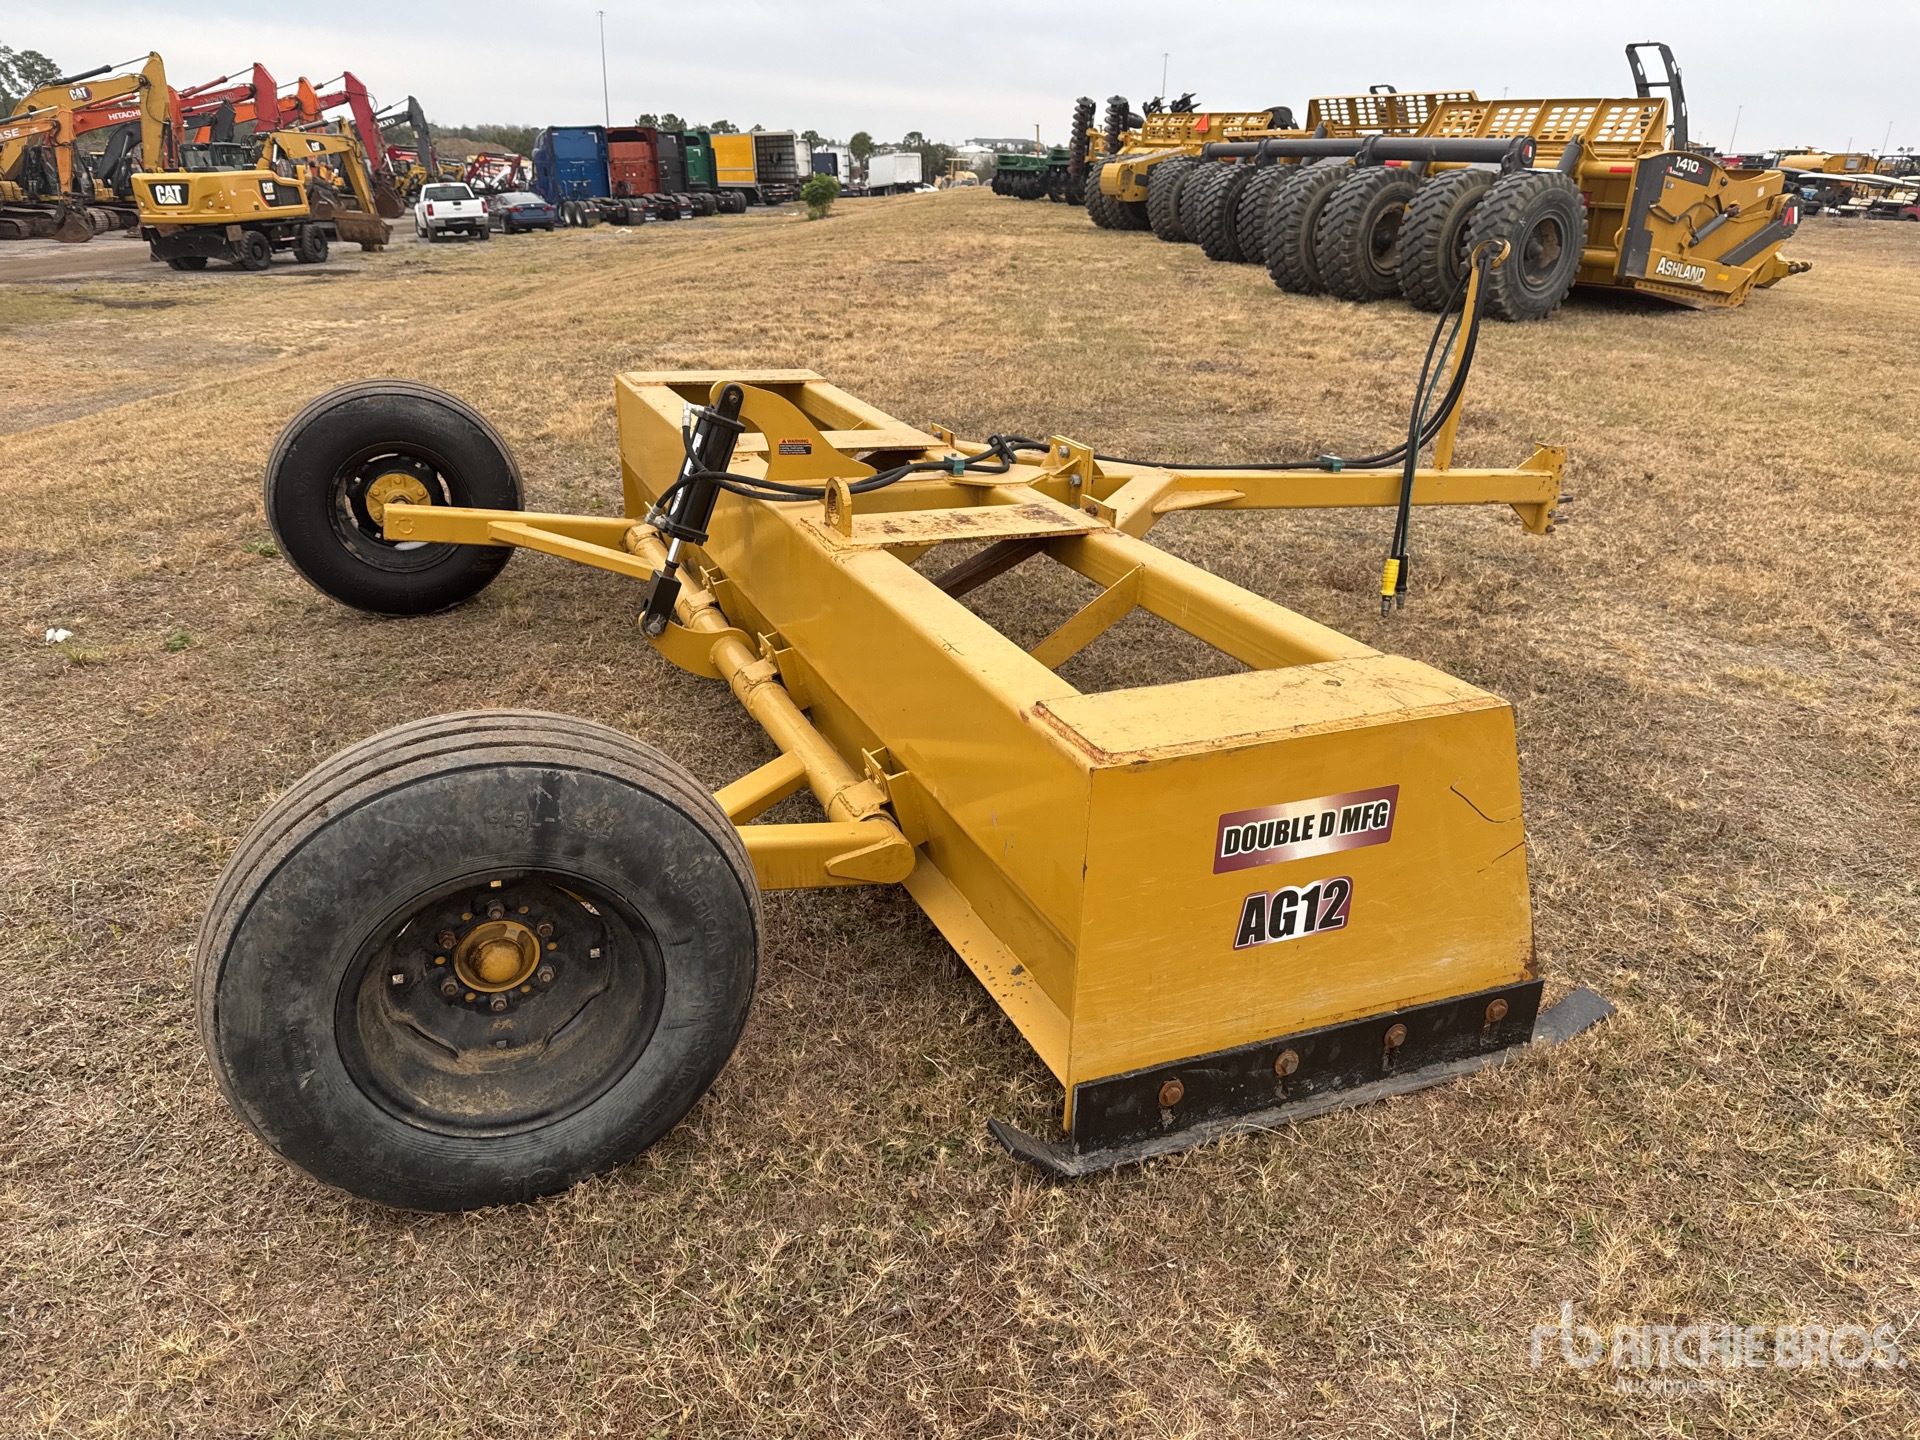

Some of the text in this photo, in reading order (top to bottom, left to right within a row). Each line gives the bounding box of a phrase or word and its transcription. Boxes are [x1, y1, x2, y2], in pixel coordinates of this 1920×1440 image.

[69, 86, 88, 100] CAT
[108, 110, 142, 121] HITACHI
[155, 185, 182, 204] CAT
[262, 182, 274, 193] CAT
[1655, 257, 1706, 283] ASHLAND
[1223, 801, 1389, 856] DOUBLE D MFG
[1236, 879, 1349, 947] AG12
